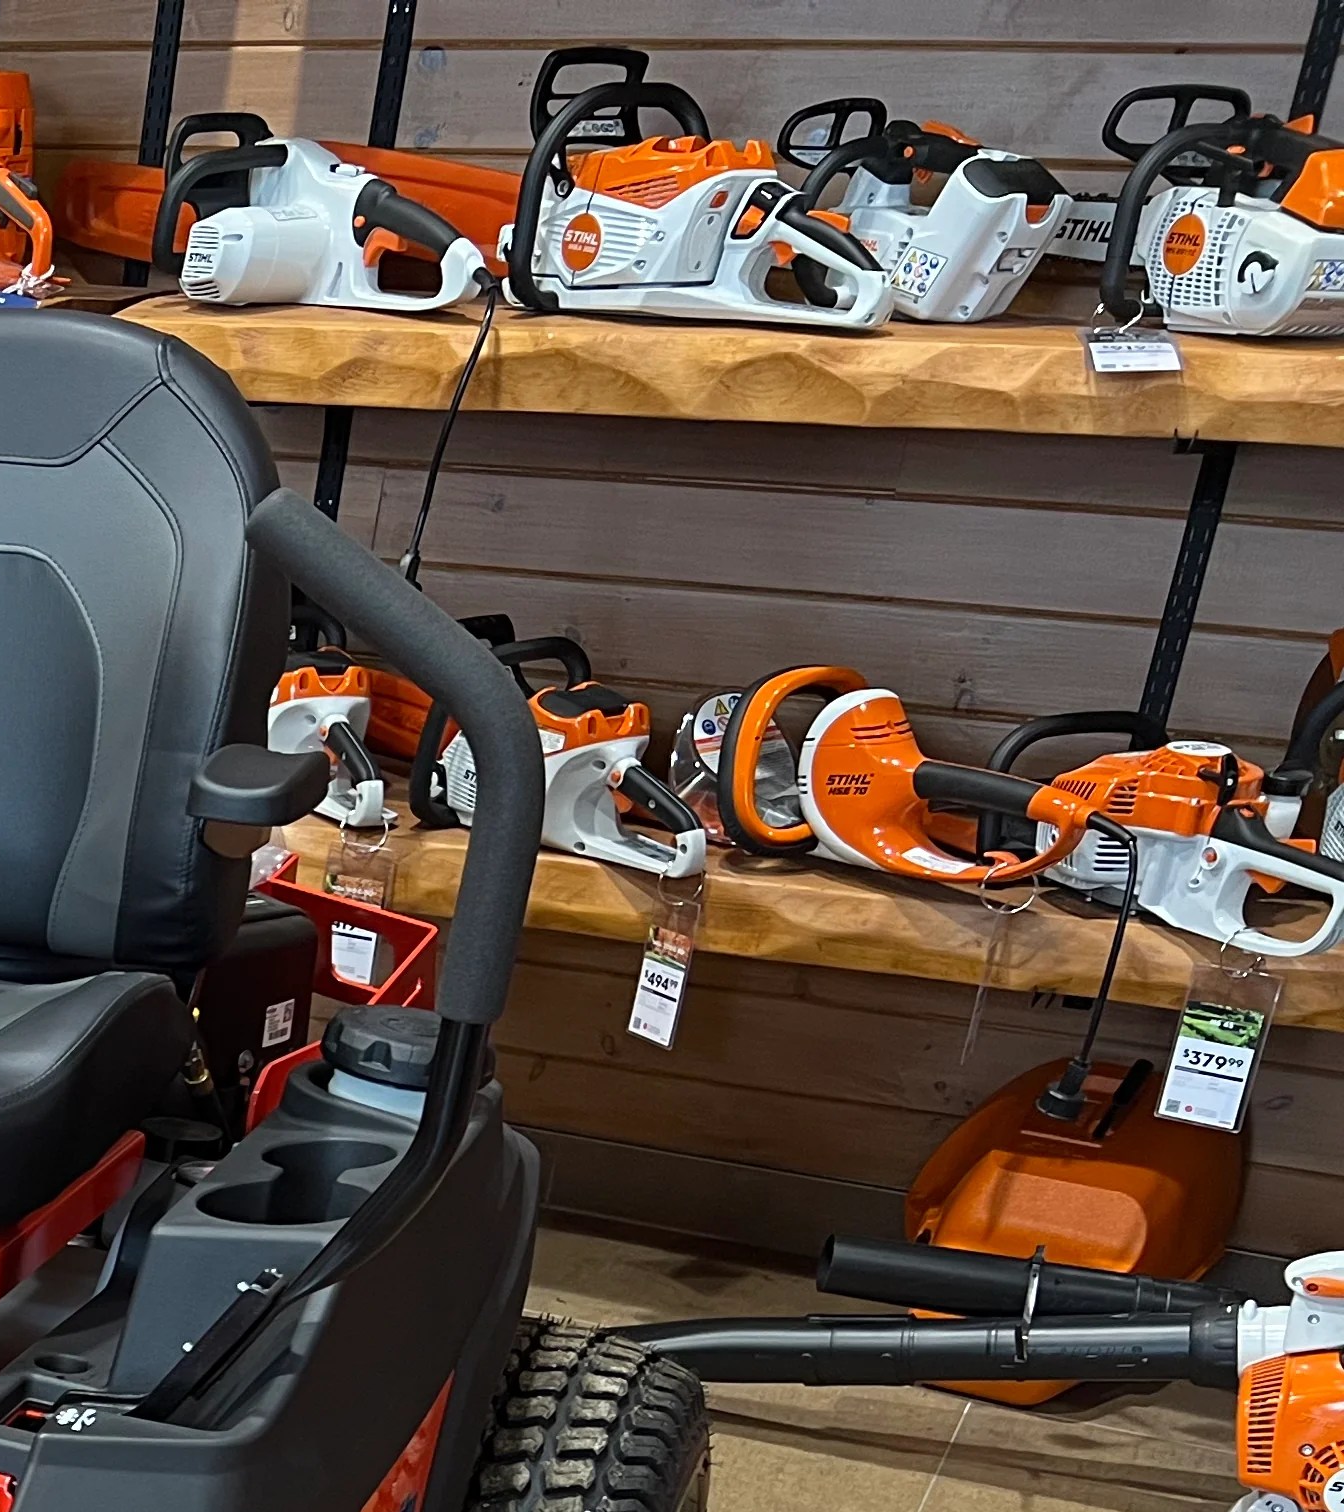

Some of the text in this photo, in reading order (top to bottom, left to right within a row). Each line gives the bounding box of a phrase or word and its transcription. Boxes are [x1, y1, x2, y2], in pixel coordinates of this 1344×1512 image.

[564, 229, 598, 246] STIHL
[1166, 232, 1201, 247] STIHL
[188, 253, 213, 263] STIHL
[826, 774, 872, 785] STIHL
[853, 786, 868, 795] 70
